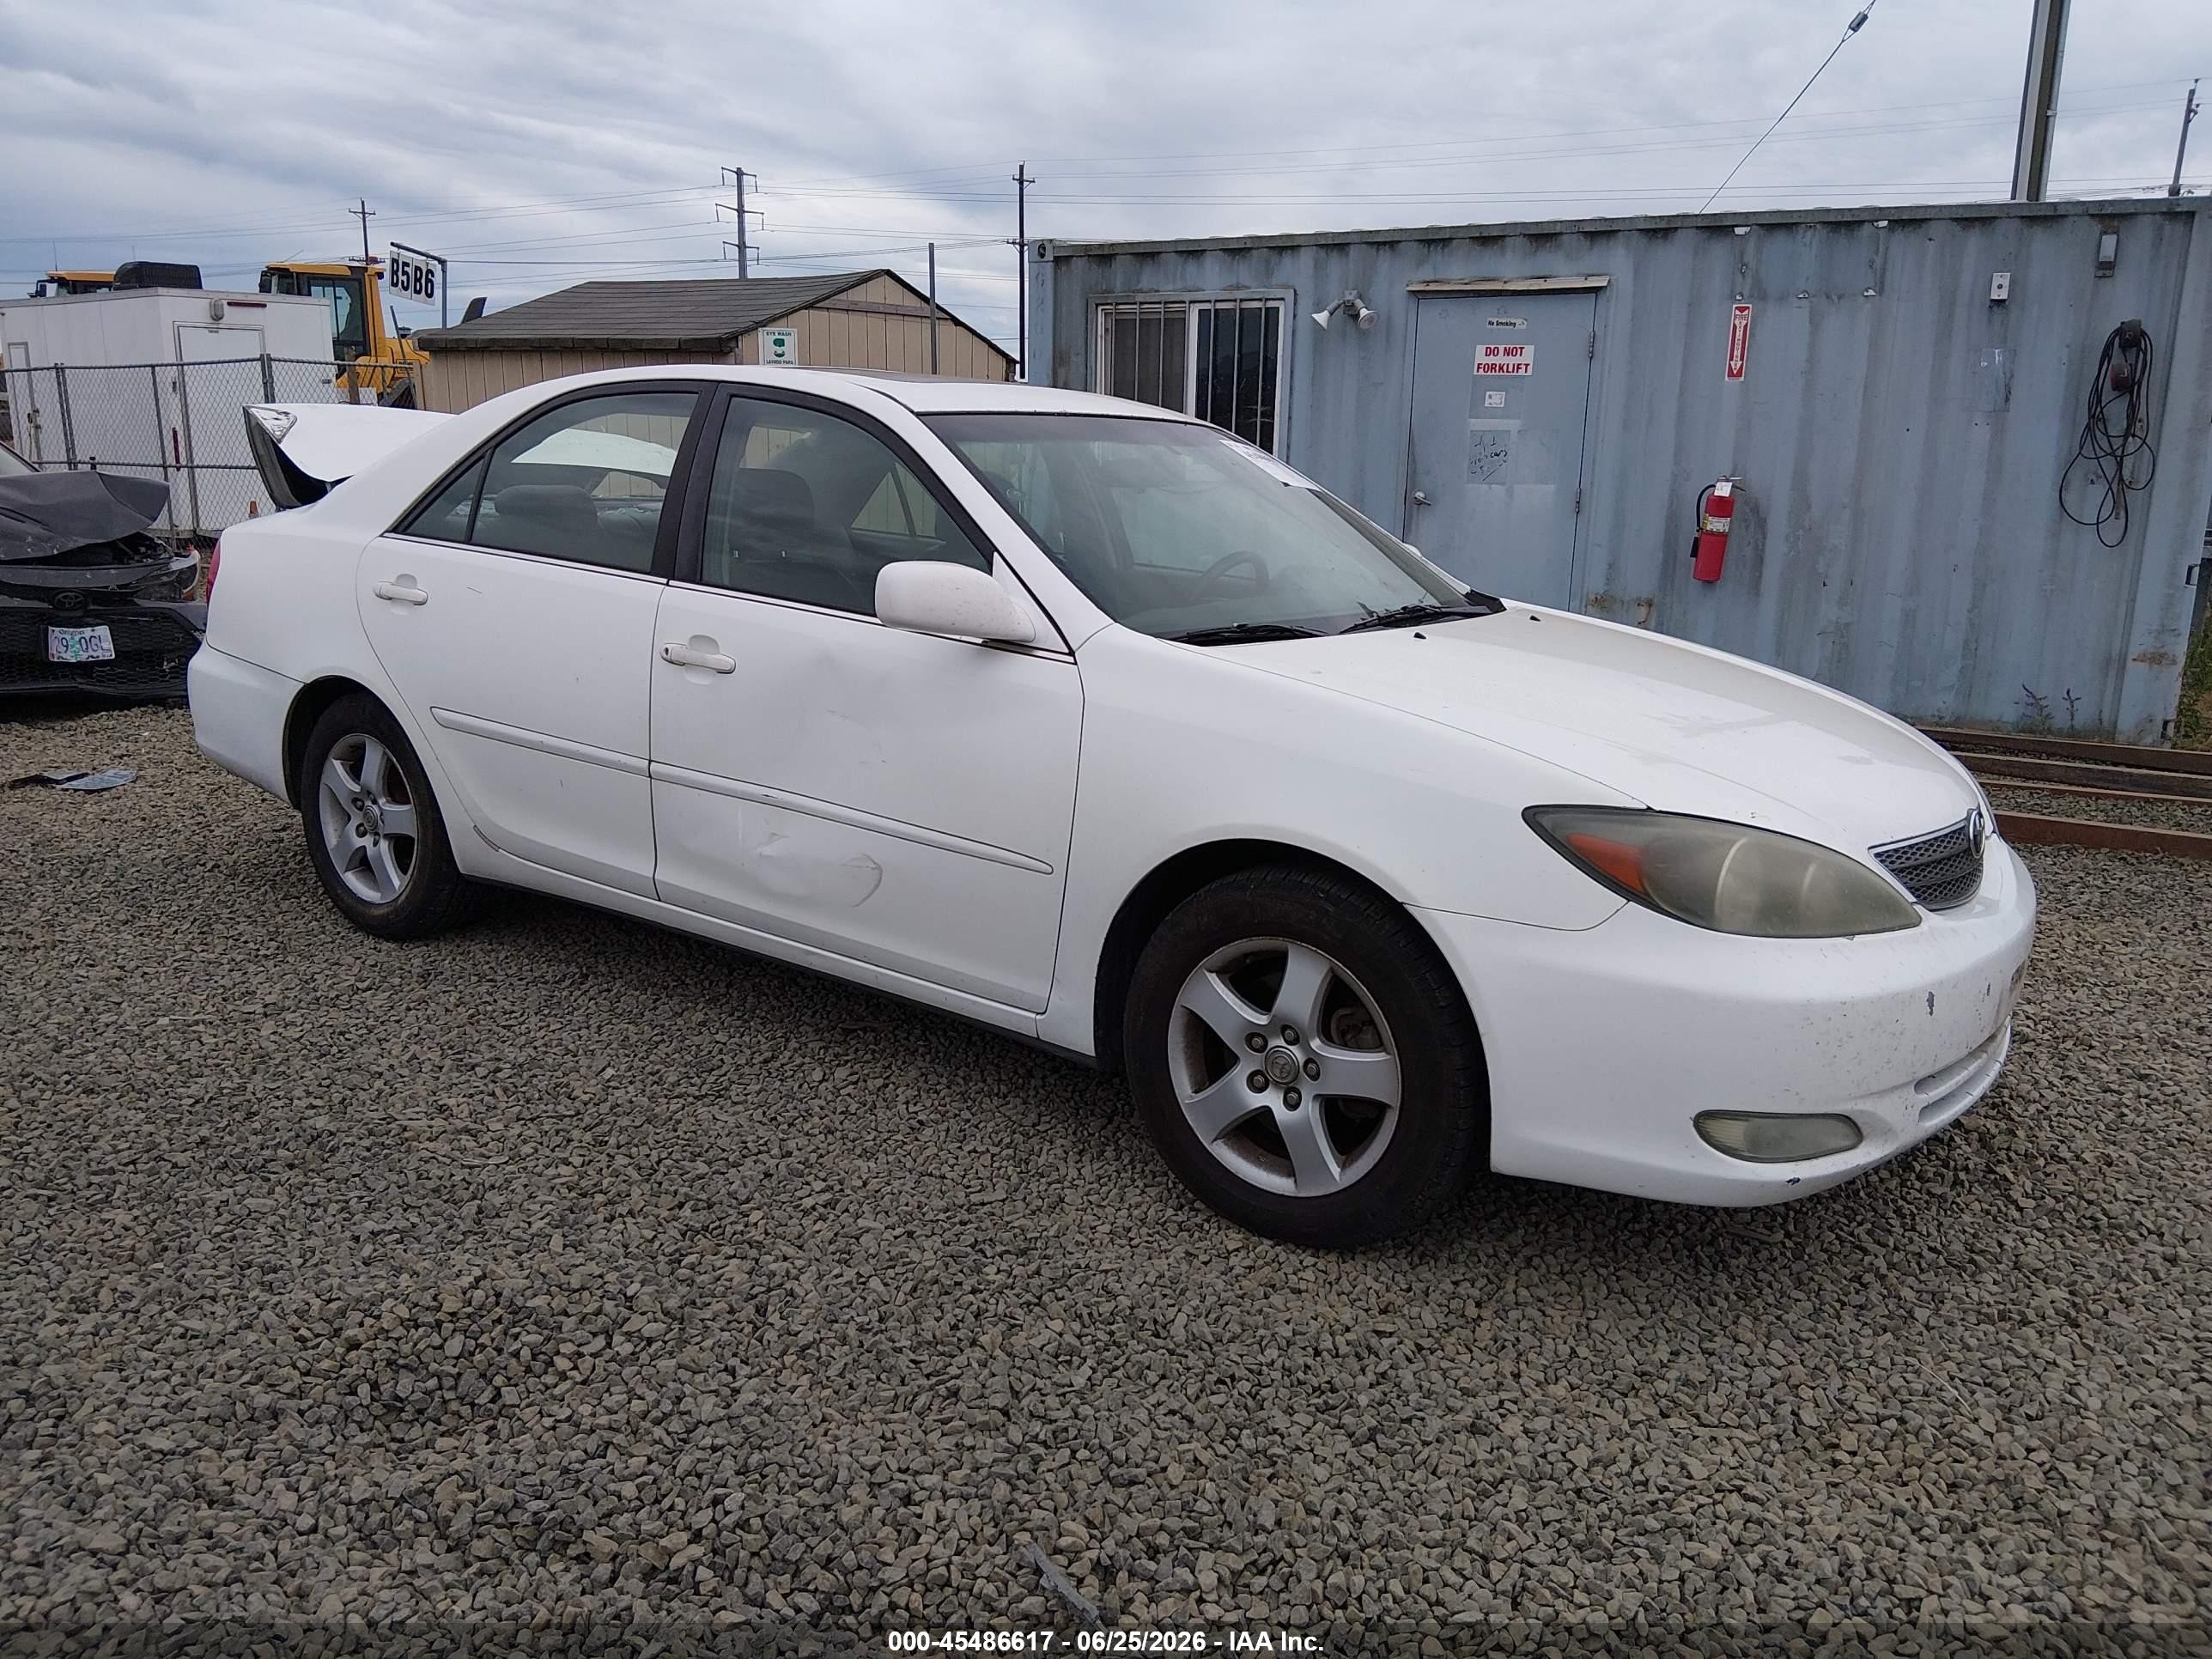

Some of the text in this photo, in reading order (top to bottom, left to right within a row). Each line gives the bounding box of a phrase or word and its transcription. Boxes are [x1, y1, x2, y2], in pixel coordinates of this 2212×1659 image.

[391, 258, 435, 299] B5 B6
[1496, 319, 1516, 328] Smoking
[1485, 346, 1526, 357] DO NOT
[1476, 362, 1530, 374] FORKLIFT
